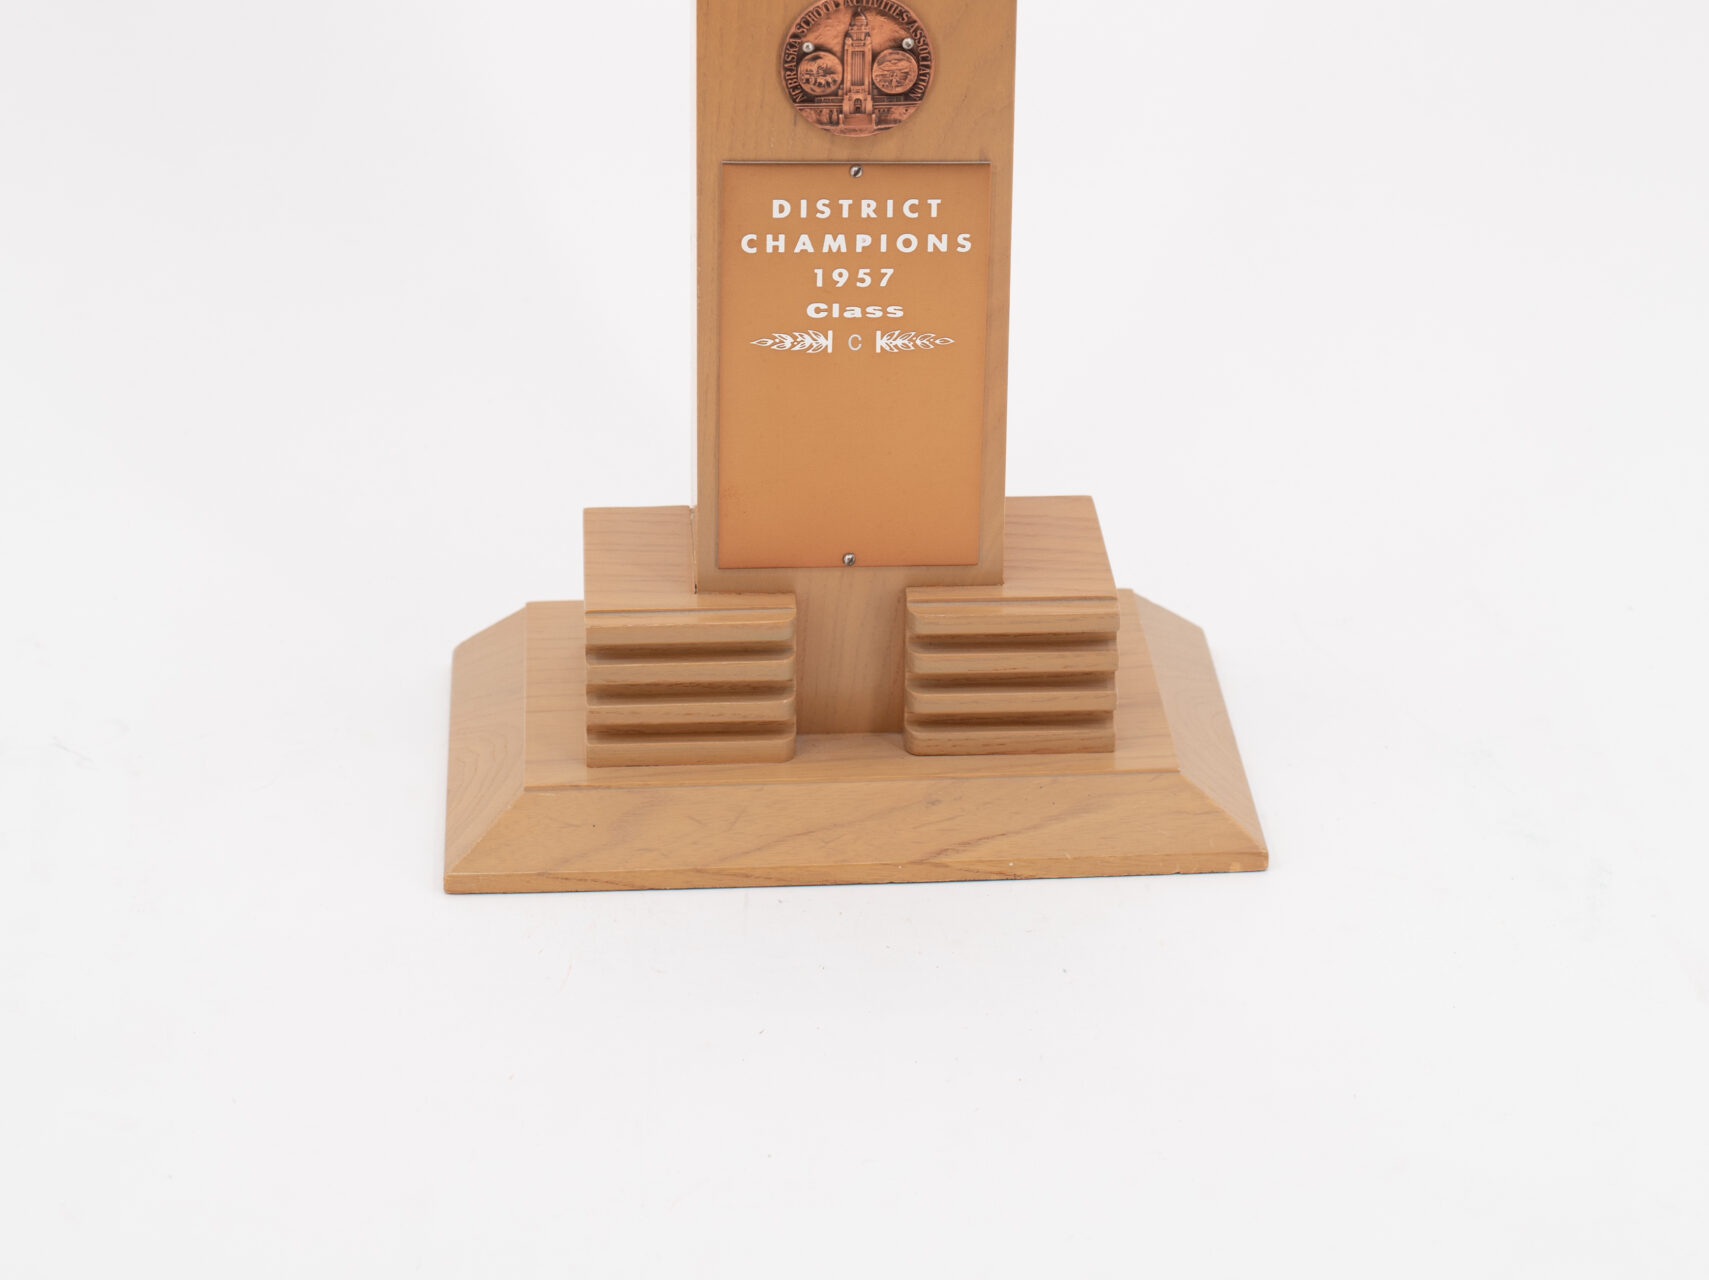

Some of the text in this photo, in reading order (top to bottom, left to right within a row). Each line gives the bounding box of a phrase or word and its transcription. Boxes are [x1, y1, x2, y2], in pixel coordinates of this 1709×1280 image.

[784, 38, 805, 102] NEBRASKA
[795, 0, 840, 35] SCHOOL
[906, 22, 931, 101] ASSOCIATION
[772, 198, 942, 219] DISTRICT
[741, 233, 972, 254] CHAMPIONS
[814, 268, 894, 288] 1957
[806, 302, 904, 319] Class
[848, 334, 862, 351] C
